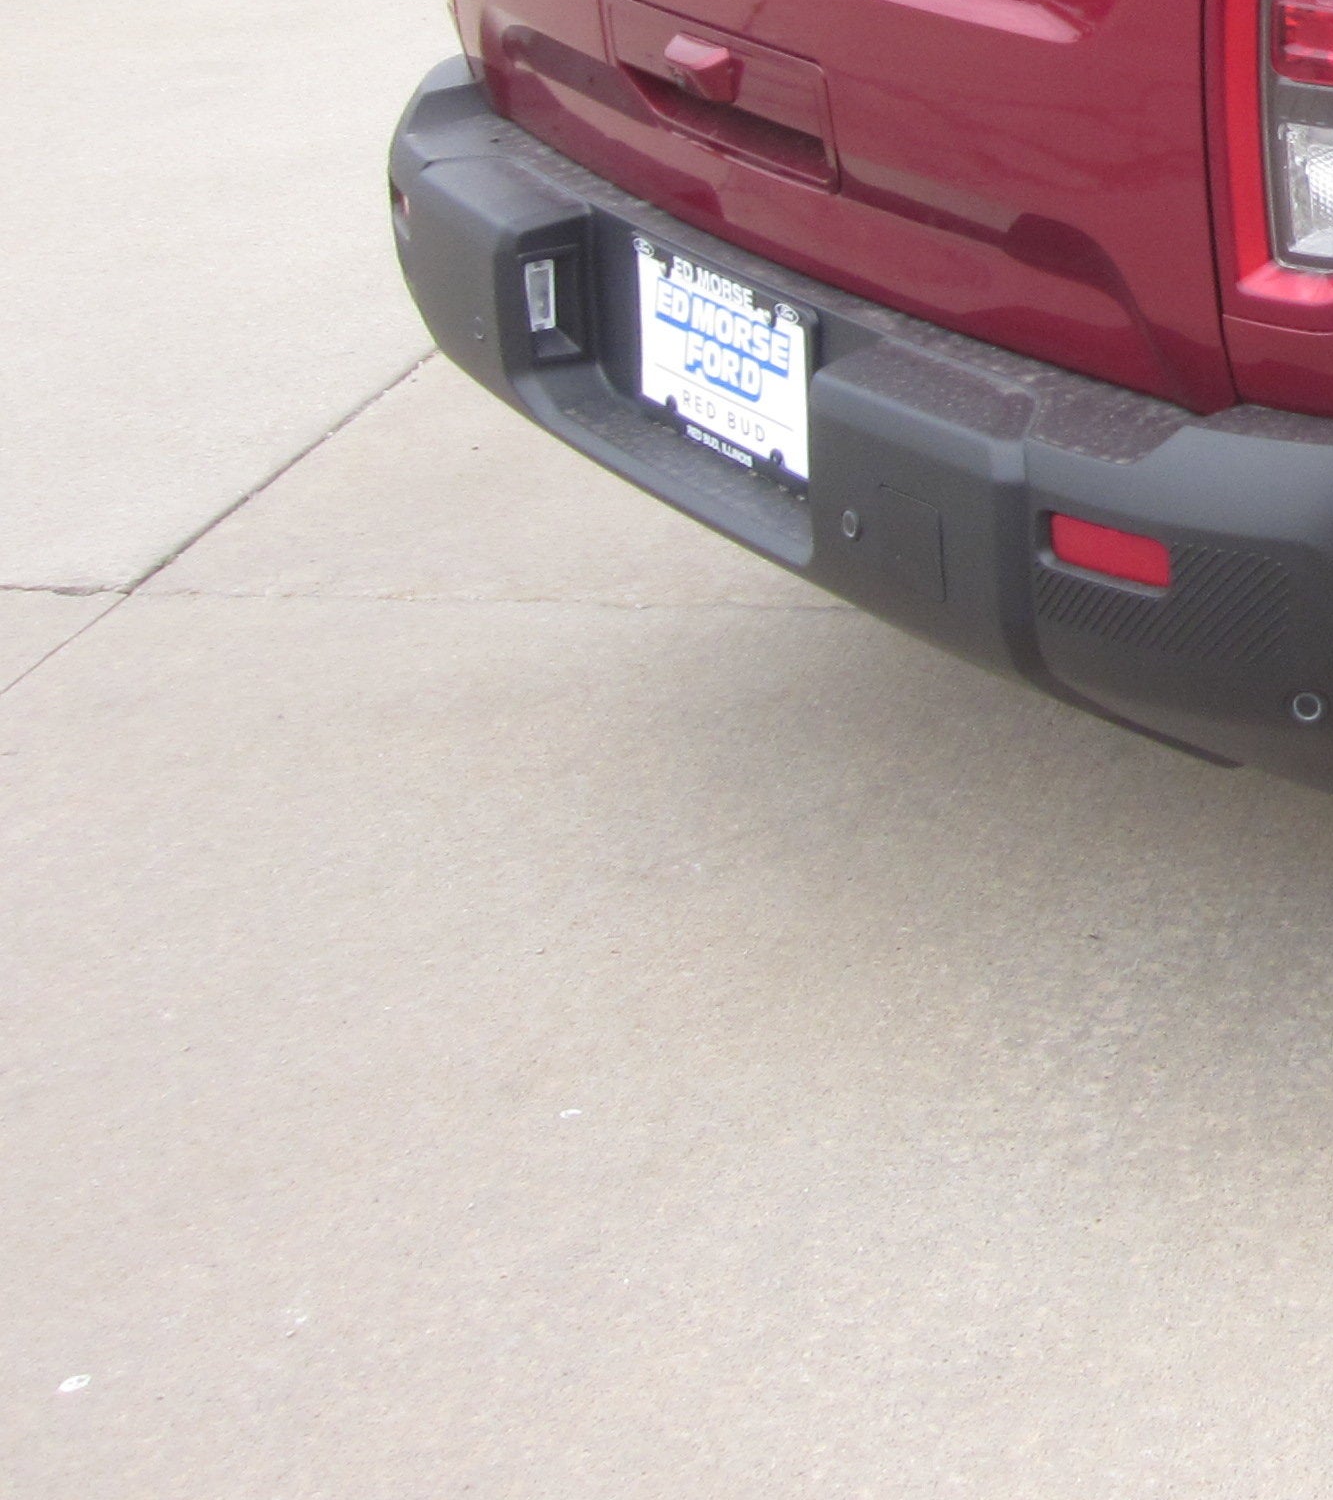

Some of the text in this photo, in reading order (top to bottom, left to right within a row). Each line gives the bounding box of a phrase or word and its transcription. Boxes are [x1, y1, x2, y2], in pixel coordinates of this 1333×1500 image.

[671, 256, 753, 309] ED MORSE
[656, 277, 791, 379] ED MORSE
[685, 331, 763, 403] FORD
[682, 389, 766, 443] RED BUD
